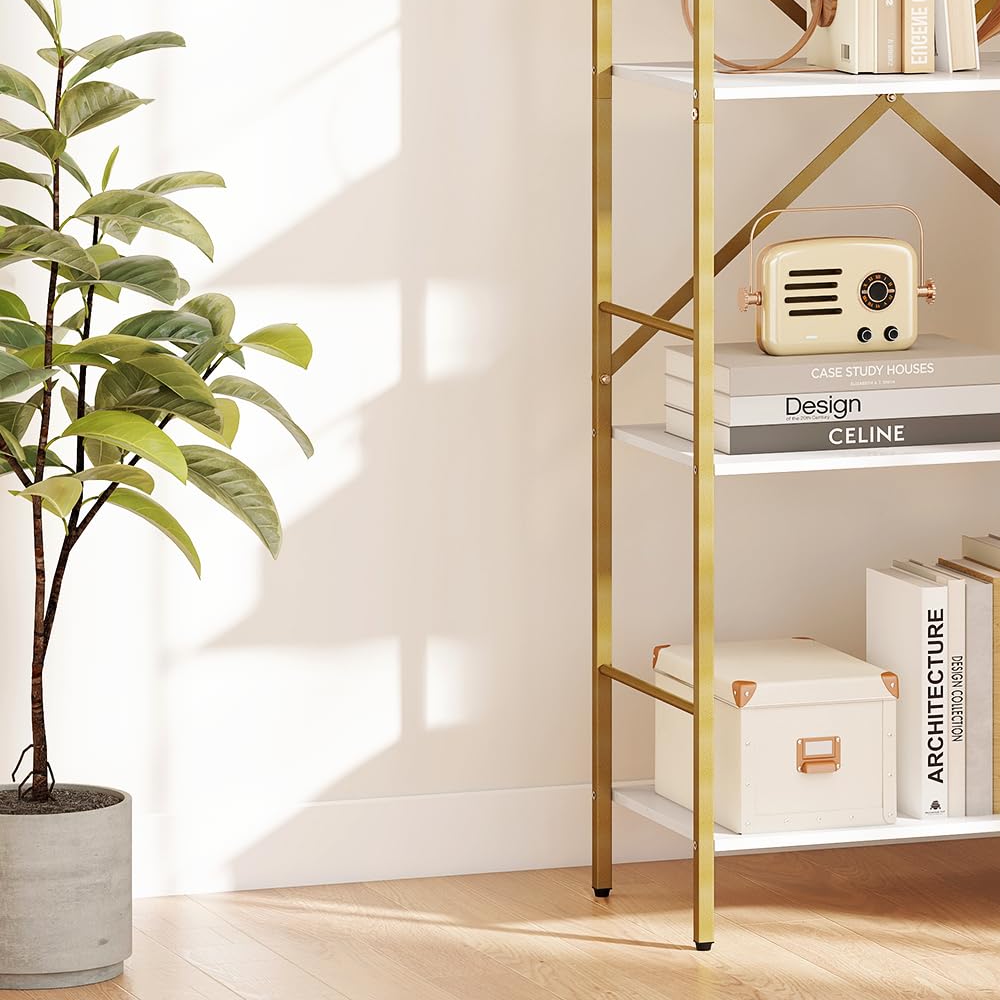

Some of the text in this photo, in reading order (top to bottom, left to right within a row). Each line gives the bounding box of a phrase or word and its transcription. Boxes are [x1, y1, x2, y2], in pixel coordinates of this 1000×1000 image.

[811, 362, 935, 379] CASE STUDY HOUSES
[786, 395, 861, 419] Design
[828, 425, 905, 445] CELINE
[927, 608, 944, 783] ARCHITECTURE
[951, 655, 963, 742] DESIGN COLLECTION
